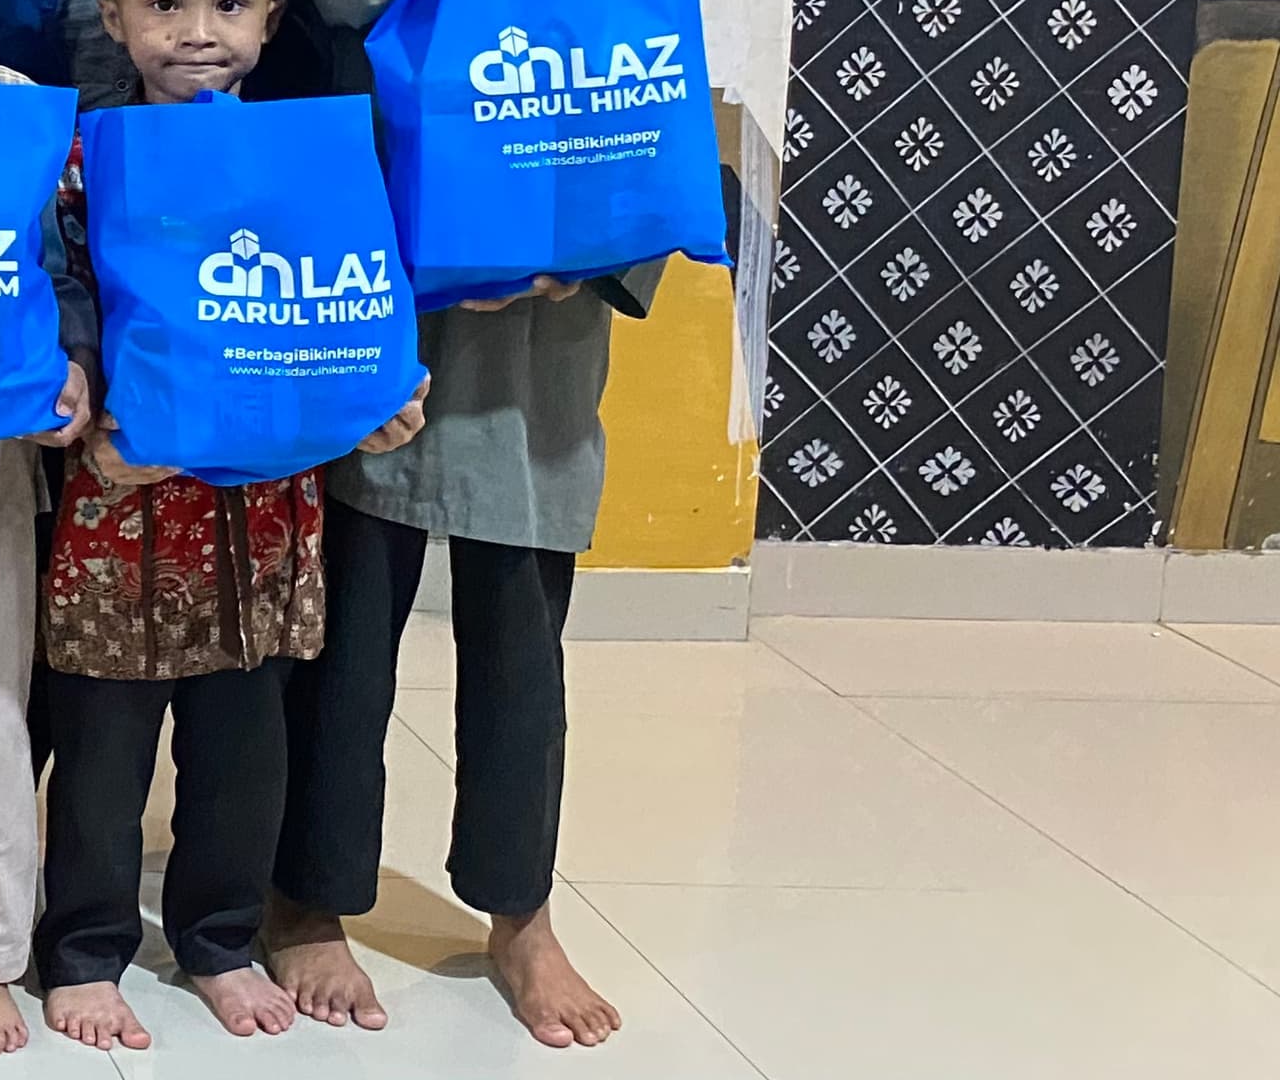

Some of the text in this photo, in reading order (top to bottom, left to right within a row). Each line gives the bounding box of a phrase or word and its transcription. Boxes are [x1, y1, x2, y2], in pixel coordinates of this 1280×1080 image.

[570, 33, 684, 89] LAZ
[473, 78, 687, 122] DARUL HIKAM
[502, 128, 661, 155] #BerbagiBikinHappy
[300, 250, 391, 299] LAZ
[197, 294, 394, 326] DARUL HIKAM
[223, 346, 382, 364] #BerbagiBikinHappy
